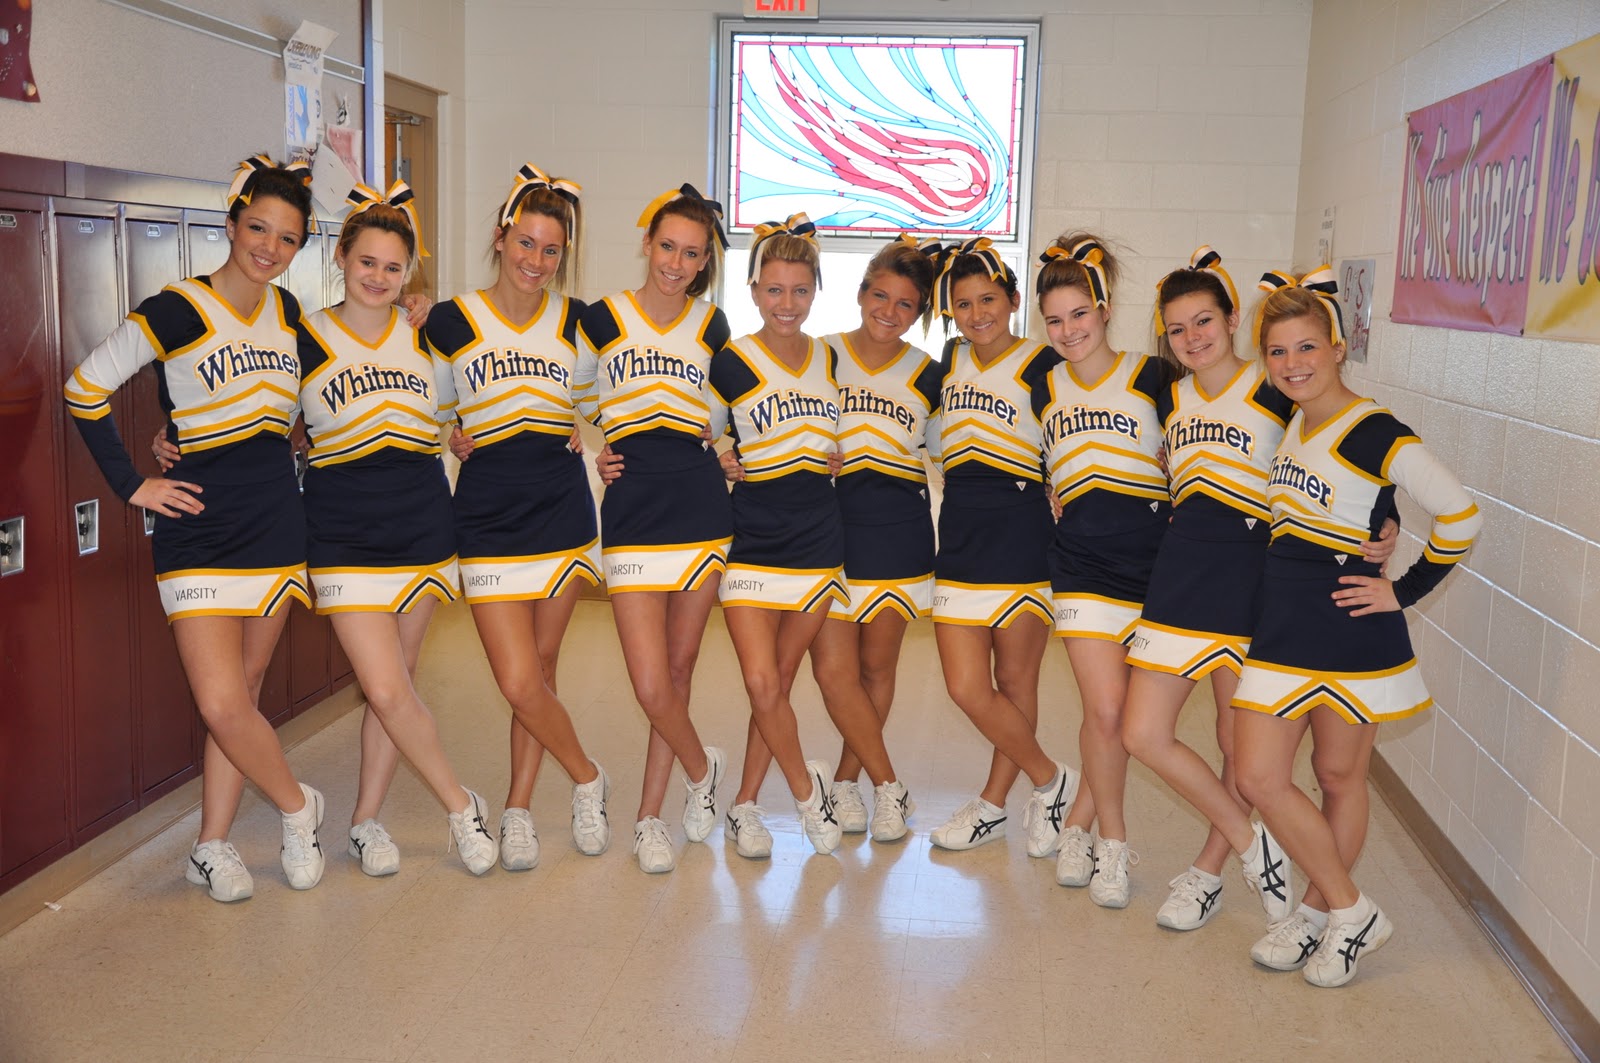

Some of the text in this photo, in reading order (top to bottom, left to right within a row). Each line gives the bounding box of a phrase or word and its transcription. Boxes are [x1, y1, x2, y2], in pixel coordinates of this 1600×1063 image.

[1539, 75, 1581, 286] We
[196, 341, 300, 394] Whitmer
[321, 365, 431, 415] Whitmer
[464, 347, 571, 395] Whitmer
[605, 346, 706, 392] Whitmer
[838, 386, 917, 435] hitmer
[1042, 405, 1141, 453] Whitmer
[1268, 454, 1332, 511] hitmer
[466, 574, 502, 587] VARSITY
[609, 563, 644, 576] VARSITY
[727, 579, 765, 592] VARSITY
[174, 587, 218, 602] VARSITY
